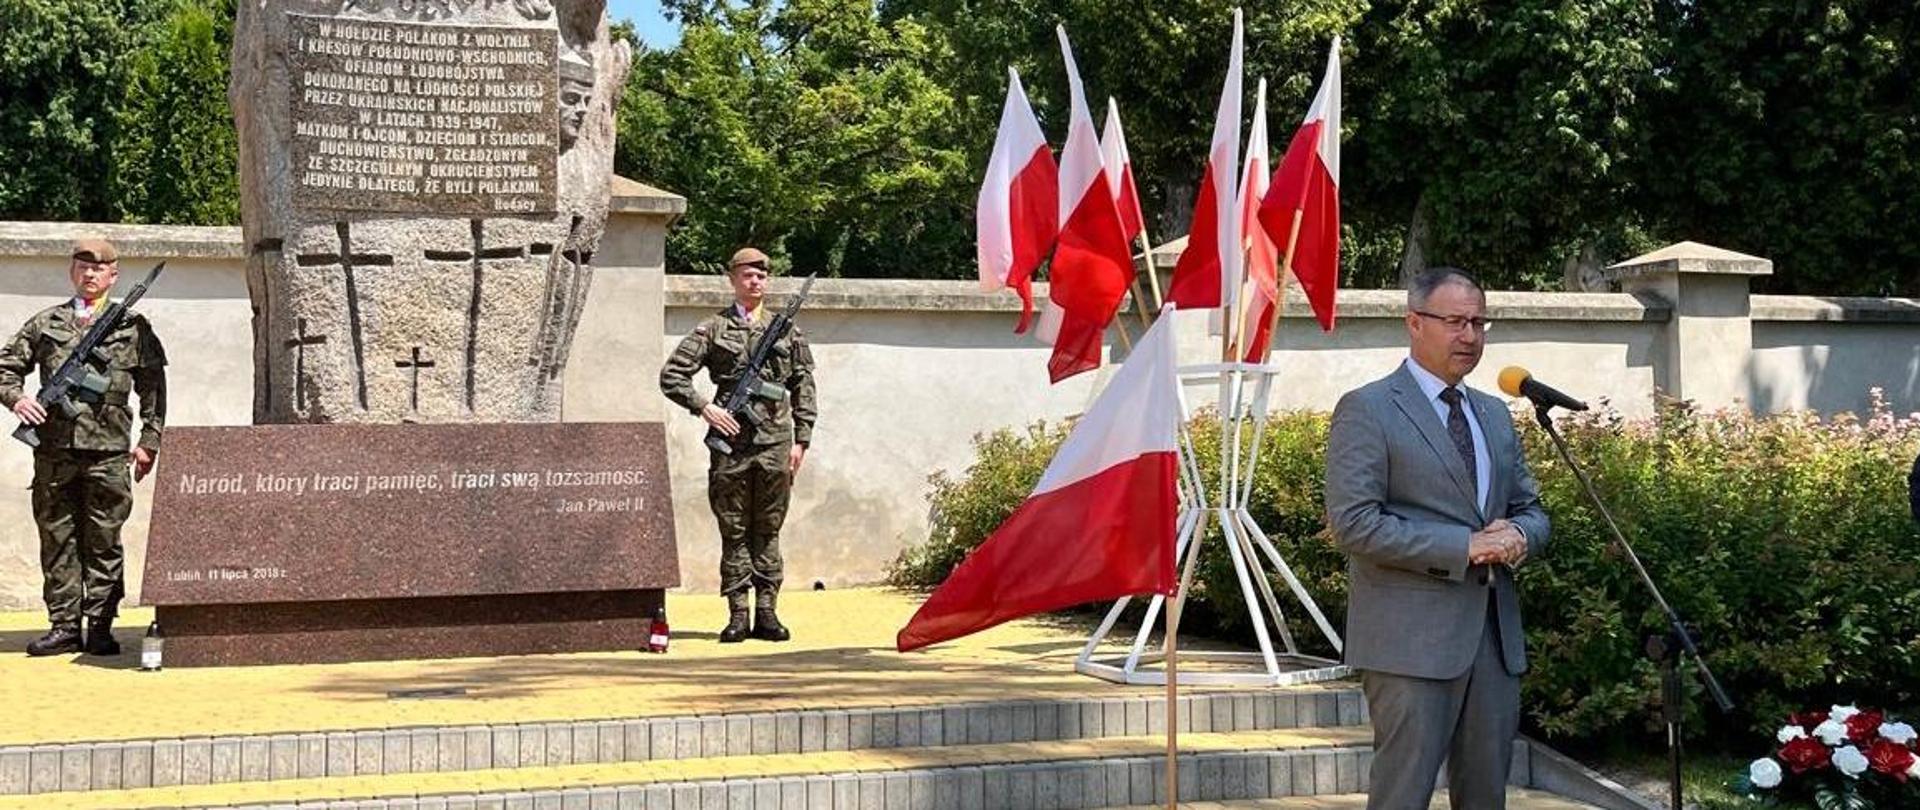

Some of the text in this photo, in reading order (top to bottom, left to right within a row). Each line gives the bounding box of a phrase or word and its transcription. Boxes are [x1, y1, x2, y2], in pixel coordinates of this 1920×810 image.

[320, 23, 530, 48] W HOŁDZIE POLAKOM Z WOŁYNIA
[299, 38, 548, 66] I KRESÓW POŁUDNIOWO-WSCHODNICH,
[345, 59, 505, 80] OFIAROM LUDOBÓJSTWA
[304, 71, 543, 98] DOKONANEGO NA LUDNOŚCI POLSKIEJ
[304, 89, 344, 106] PRZEZ
[440, 97, 543, 114] NACJONALISTÓW
[297, 121, 348, 139] MATKOM
[354, 127, 358, 140] I
[363, 128, 412, 144] OJCOM,
[416, 131, 476, 145] DZIECIOM
[481, 133, 486, 145] I
[360, 112, 502, 131] W LATACH 1939-1947,
[308, 156, 539, 178] ZE SZCZEGÓLNYM OKRUCIEŃSTWEM
[444, 148, 528, 162] ZGŁADZONYM
[303, 172, 544, 197] JEDYNIE DLATEGO, ŻE BYLI POLAKAMI.
[180, 473, 247, 495] Naród,
[256, 473, 307, 495] który
[314, 472, 359, 491] traci
[366, 470, 443, 494] pamięć,
[451, 469, 496, 489] traci
[501, 471, 540, 491] swą
[557, 499, 583, 512] Jan
[635, 497, 644, 511] II
[208, 569, 218, 580] 11
[222, 568, 249, 581] lipca
[252, 567, 279, 579] 2018
